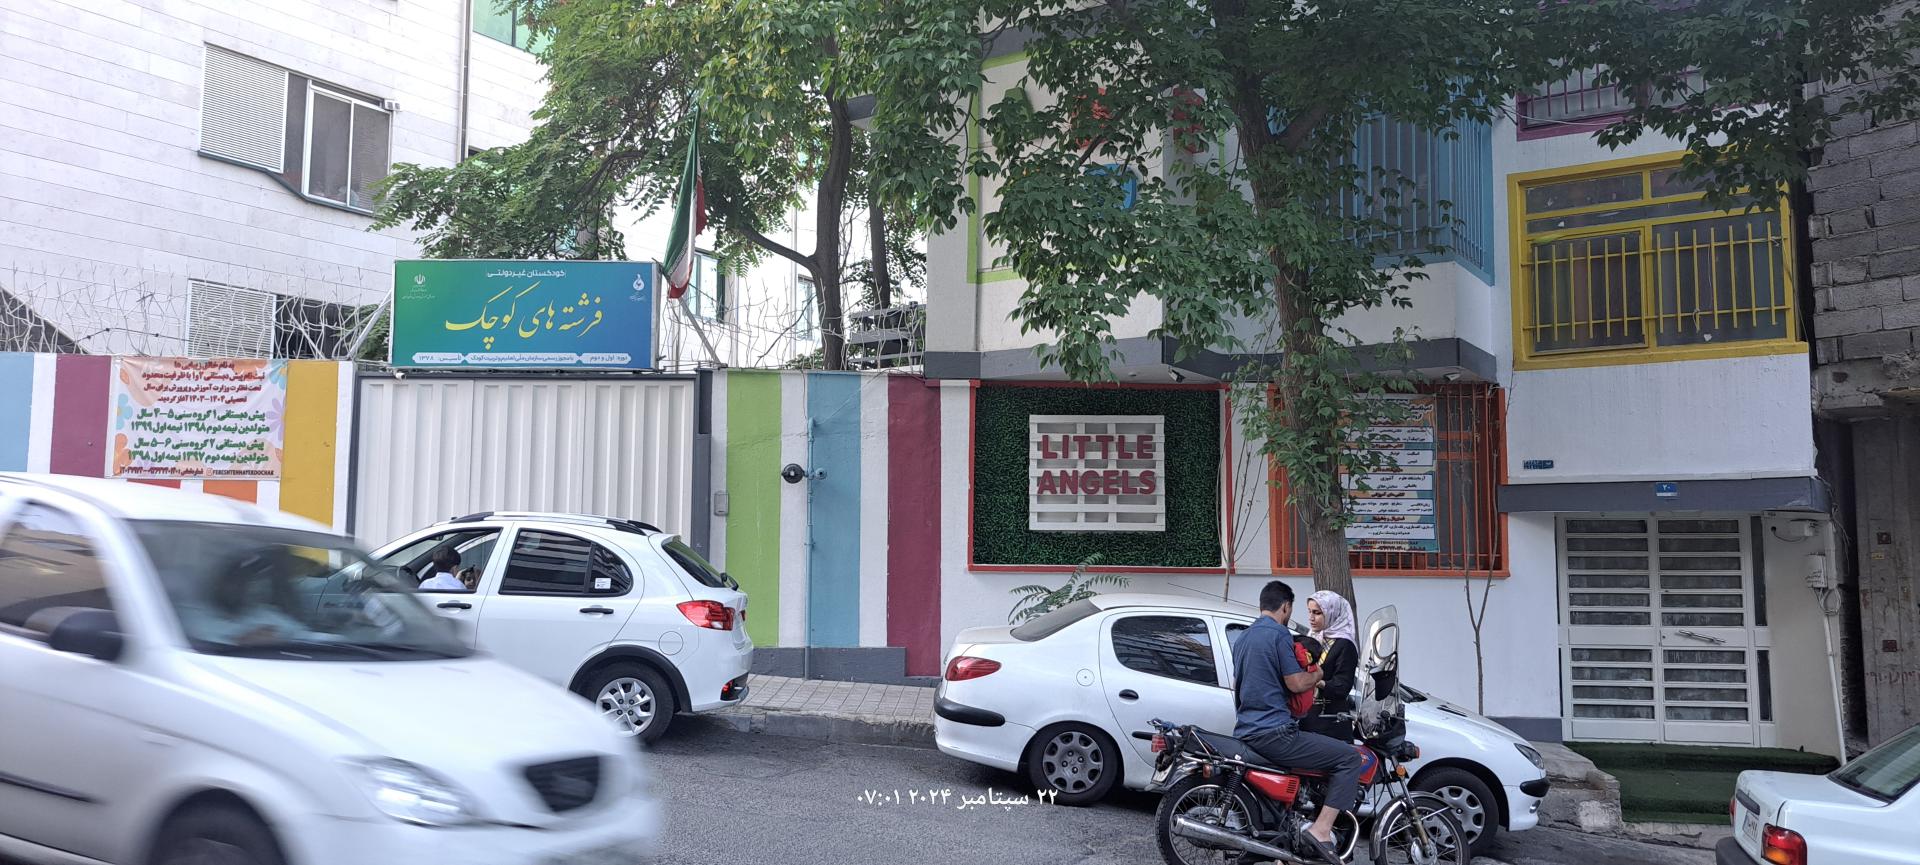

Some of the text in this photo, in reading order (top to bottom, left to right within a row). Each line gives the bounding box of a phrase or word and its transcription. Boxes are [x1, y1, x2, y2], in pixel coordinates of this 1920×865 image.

[445, 281, 603, 351] فرشته های کوچک
[144, 383, 156, 391] سال
[137, 408, 153, 420] سال
[193, 409, 212, 422] گروه
[217, 409, 249, 421] دبستانی
[248, 410, 266, 422] پیش
[152, 421, 167, 433] اول
[206, 424, 222, 434] دوم
[134, 437, 150, 449] سال
[190, 438, 210, 451] گروه
[216, 438, 247, 451] دبستانی
[247, 439, 265, 451] پیش
[1041, 434, 1154, 461] LITTLE
[151, 450, 166, 463] اول
[204, 454, 221, 464] دوم
[1037, 469, 1156, 495] ANGELS
